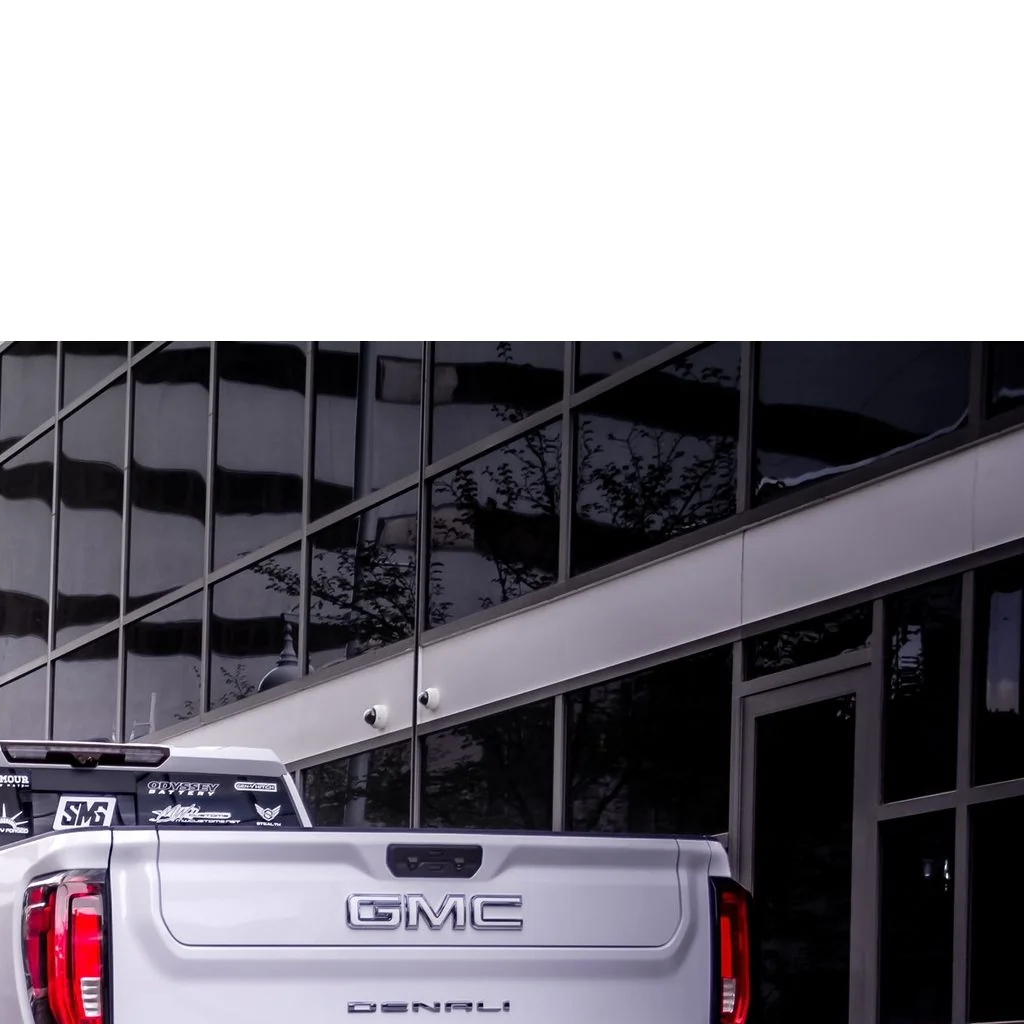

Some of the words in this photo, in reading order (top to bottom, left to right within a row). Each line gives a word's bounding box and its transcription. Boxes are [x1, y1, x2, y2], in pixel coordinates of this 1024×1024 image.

[147, 781, 219, 791] ODYSSEY
[61, 801, 109, 826] SMG
[346, 893, 524, 931] GMC
[347, 1001, 510, 1014] DENALI
